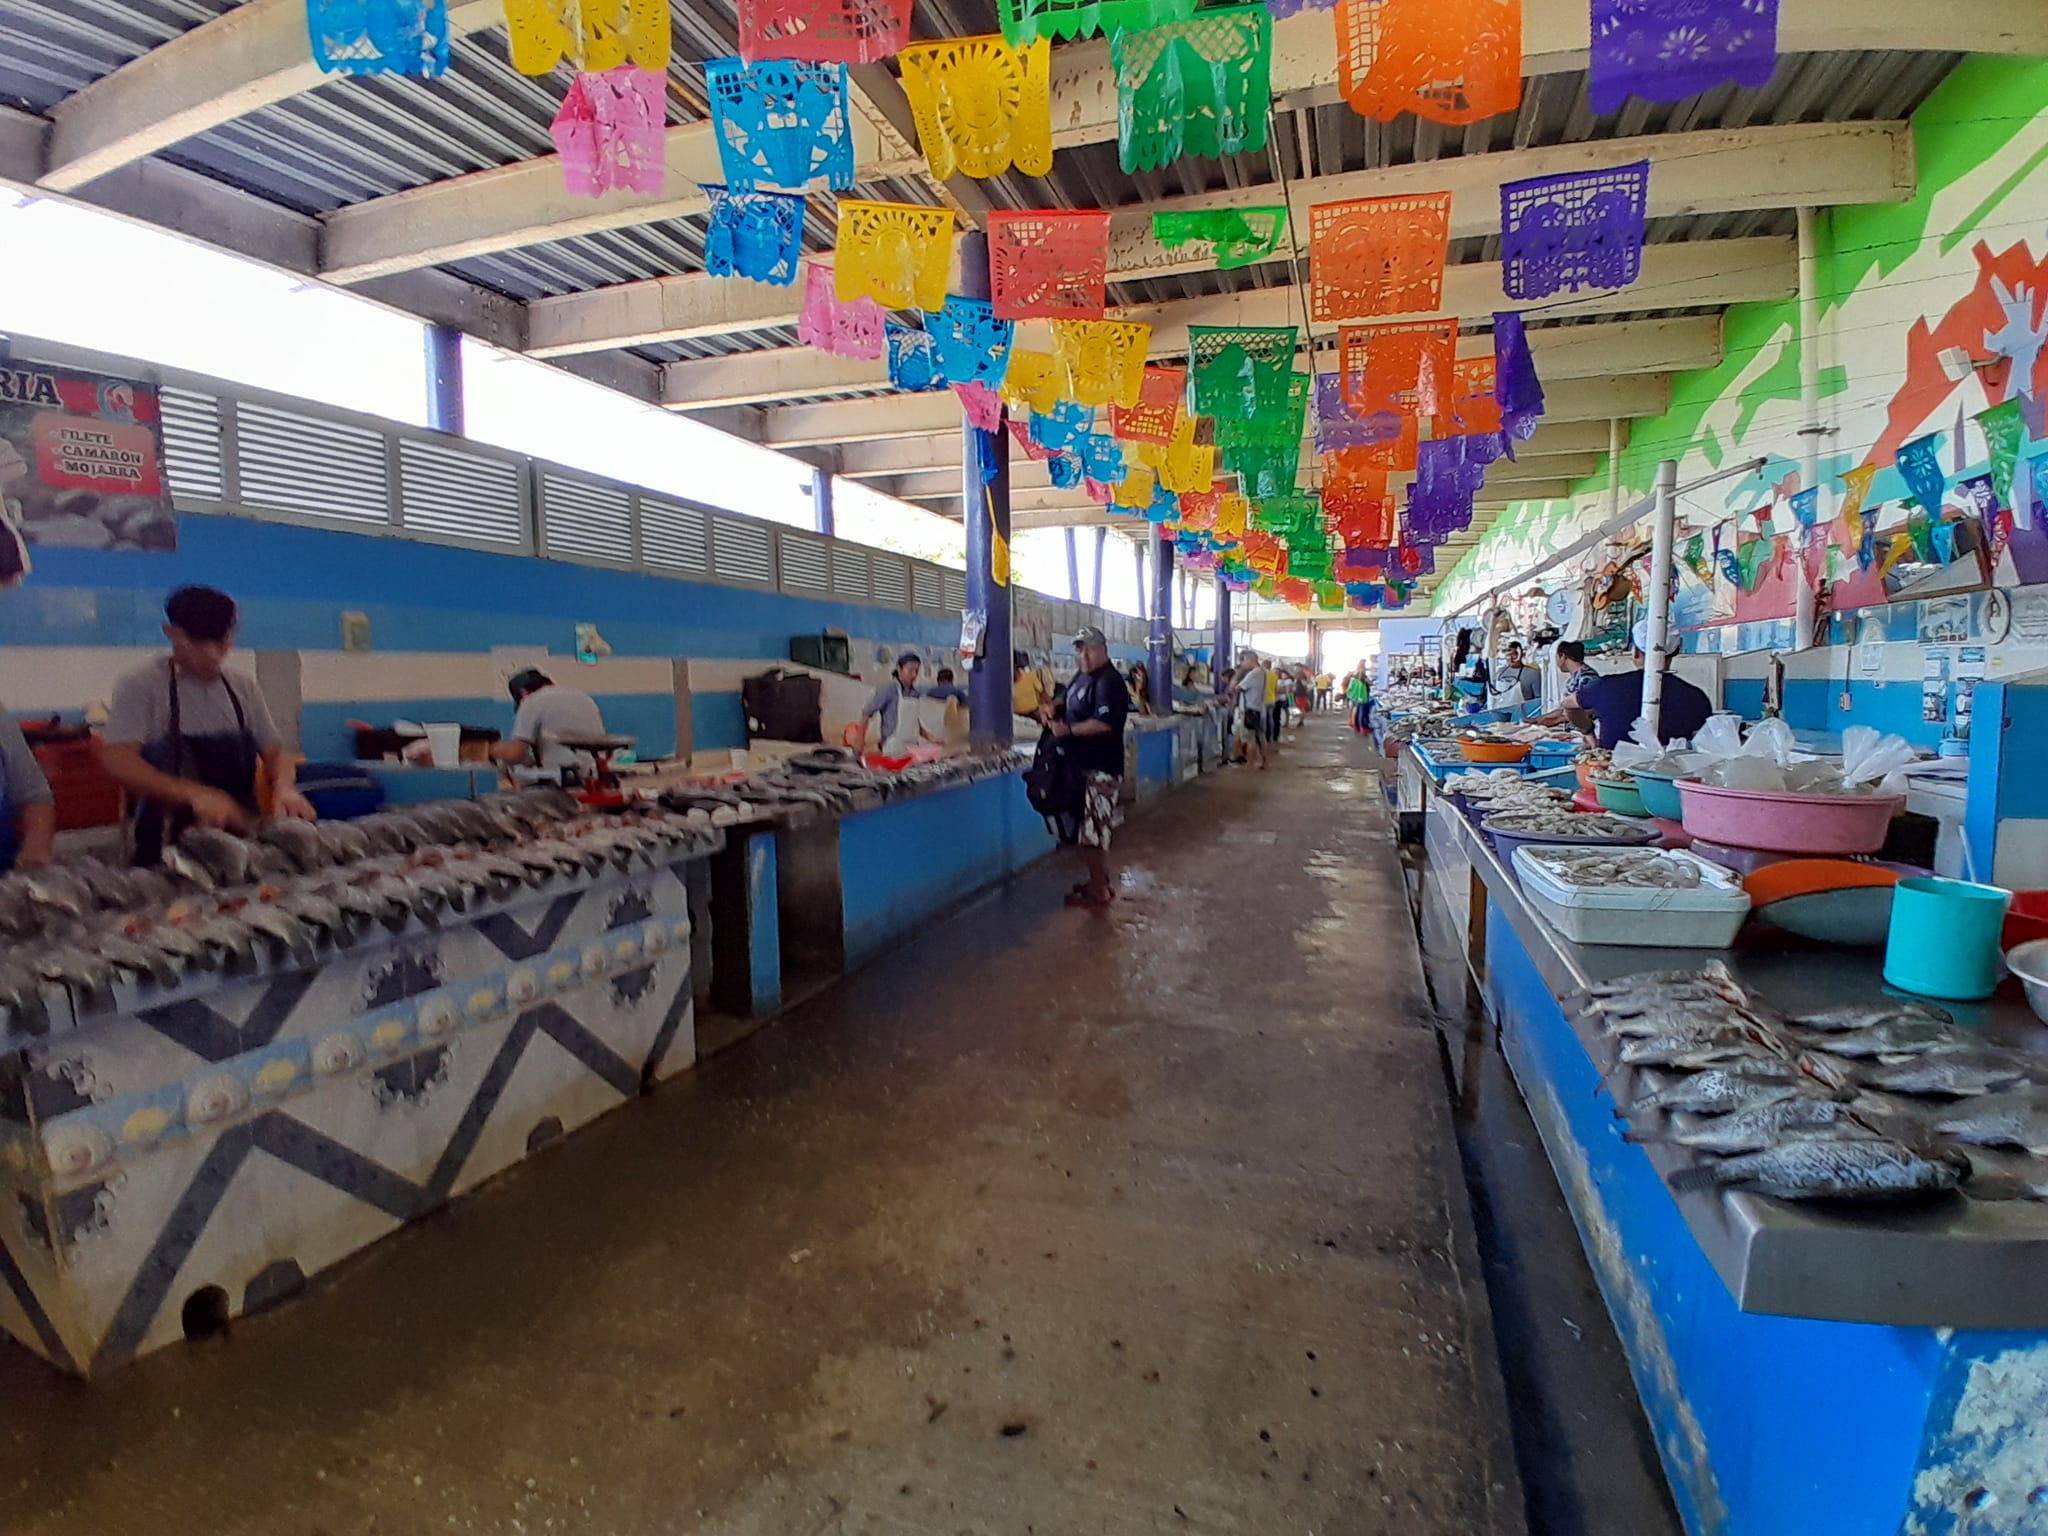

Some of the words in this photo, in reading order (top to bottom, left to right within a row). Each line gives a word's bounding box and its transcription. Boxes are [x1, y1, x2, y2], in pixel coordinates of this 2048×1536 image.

[60, 429, 113, 446] FILETE
[62, 445, 142, 464] CAMARON
[63, 461, 142, 480] MOJARRA
